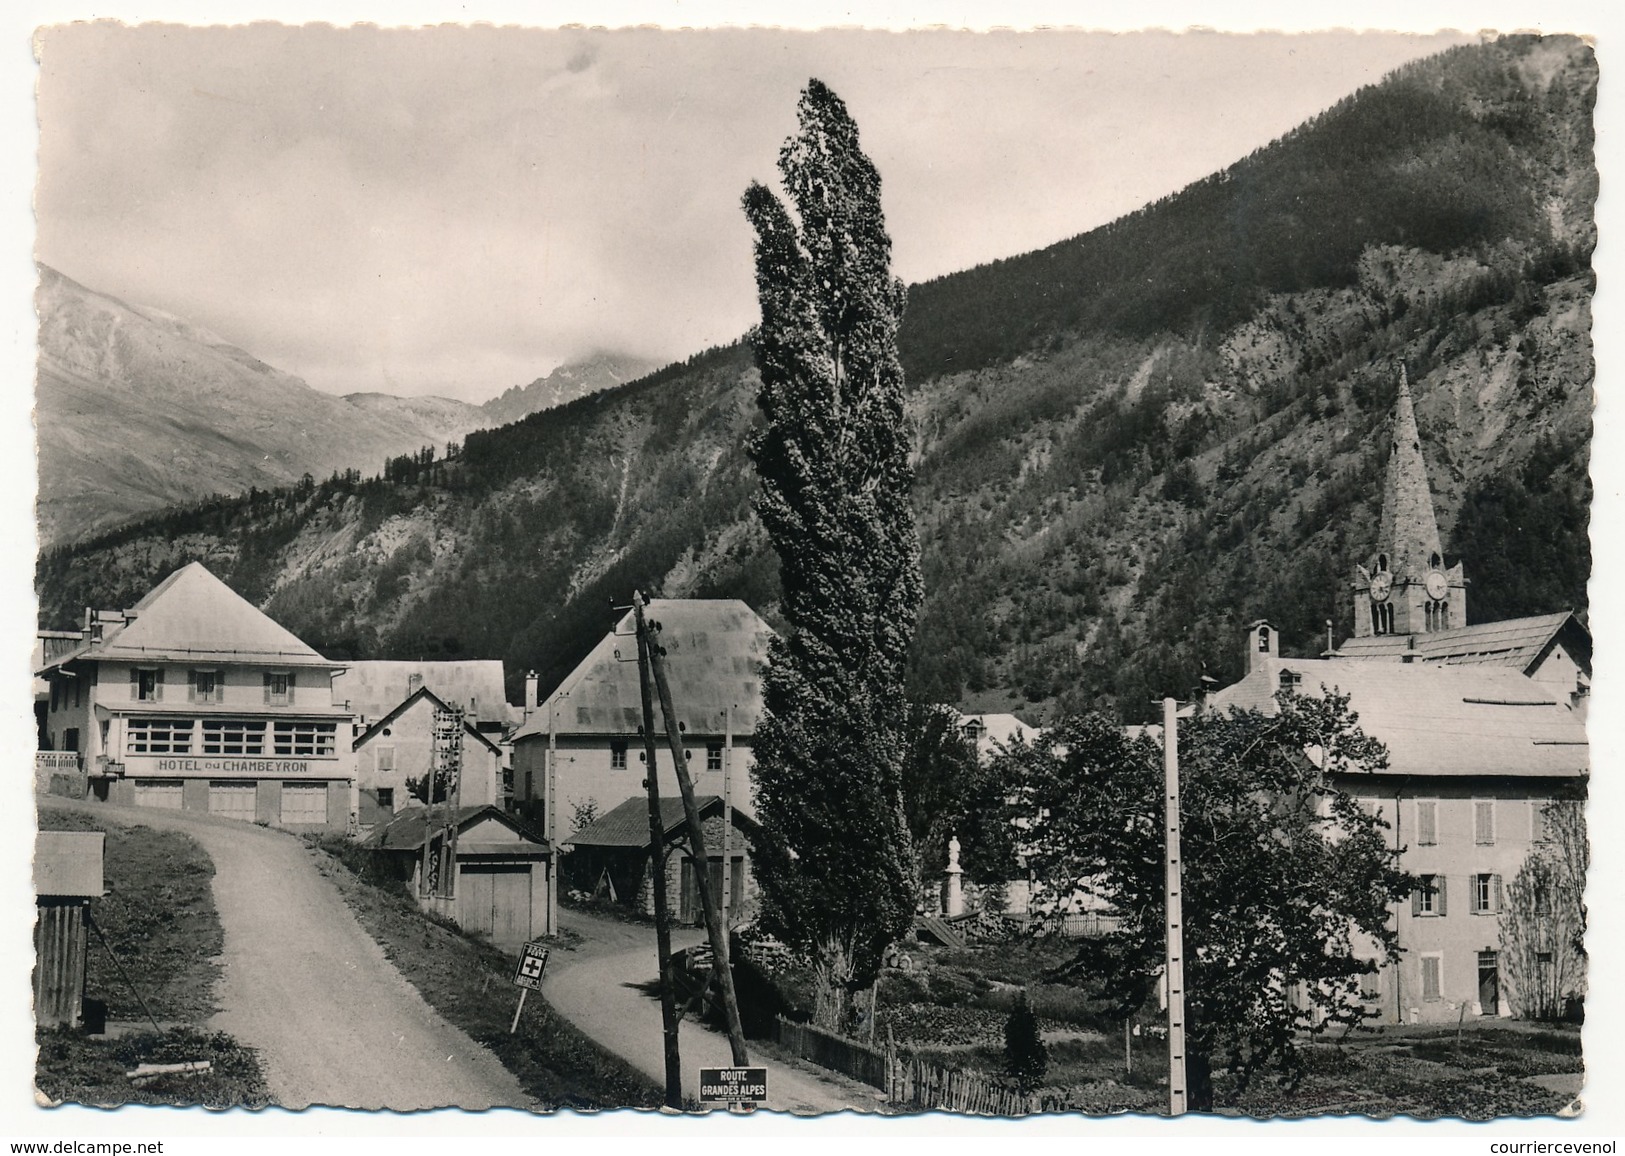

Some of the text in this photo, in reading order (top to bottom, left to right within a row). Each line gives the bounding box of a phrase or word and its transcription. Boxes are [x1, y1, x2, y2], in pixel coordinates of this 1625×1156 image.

[159, 760, 201, 771] HOTEL
[223, 761, 308, 772] CHAMBEYRON
[720, 1071, 748, 1081] ROUTE
[701, 1084, 766, 1096] GRANDES ALPES
